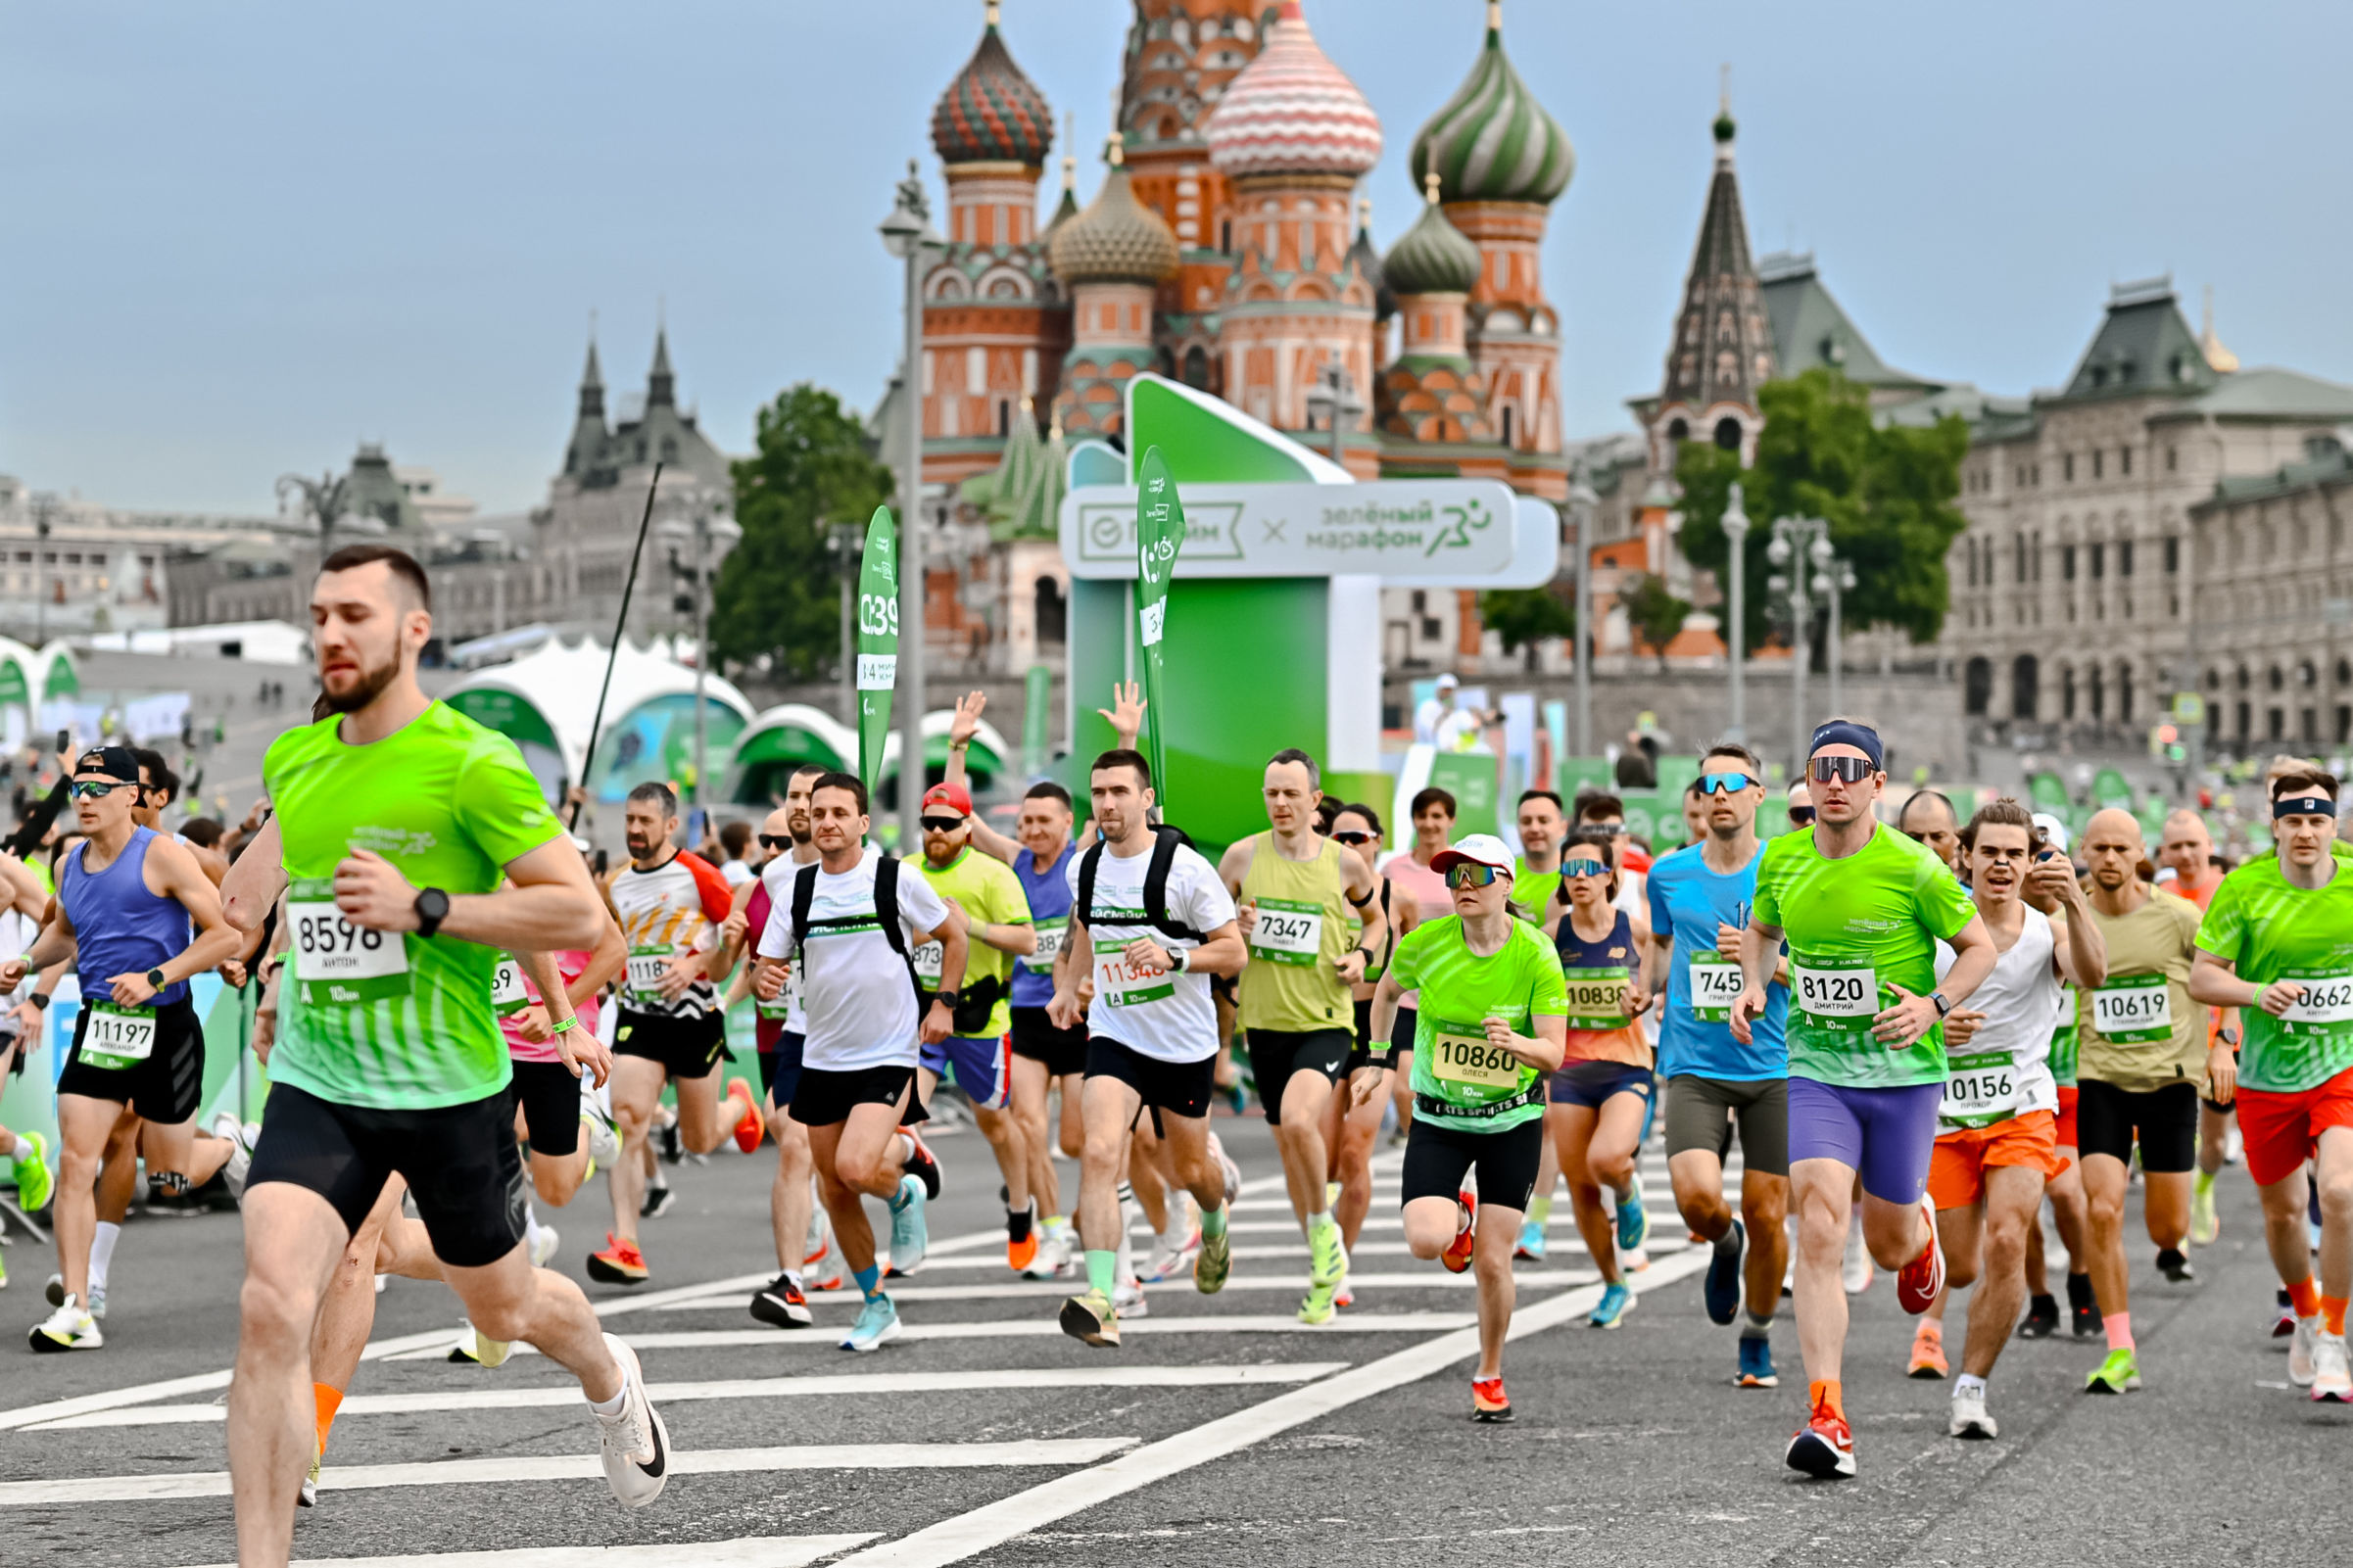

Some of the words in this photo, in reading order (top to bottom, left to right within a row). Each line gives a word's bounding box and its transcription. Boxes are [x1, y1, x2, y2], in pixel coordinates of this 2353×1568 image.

[1321, 500, 1432, 525] зелёный
[1306, 527, 1423, 554] марафон
[1261, 916, 1312, 939] 7347
[1700, 972, 1742, 992] 745
[1802, 975, 1864, 1001] 8120
[1814, 1001, 1854, 1010] ДМИТРИЙ
[2098, 993, 2165, 1018] 10619
[2297, 984, 2351, 1008] 0662
[93, 1020, 151, 1045] 11197
[1440, 1041, 1516, 1072] 10860
[1462, 1068, 1489, 1078] ОЛЕСЯ
